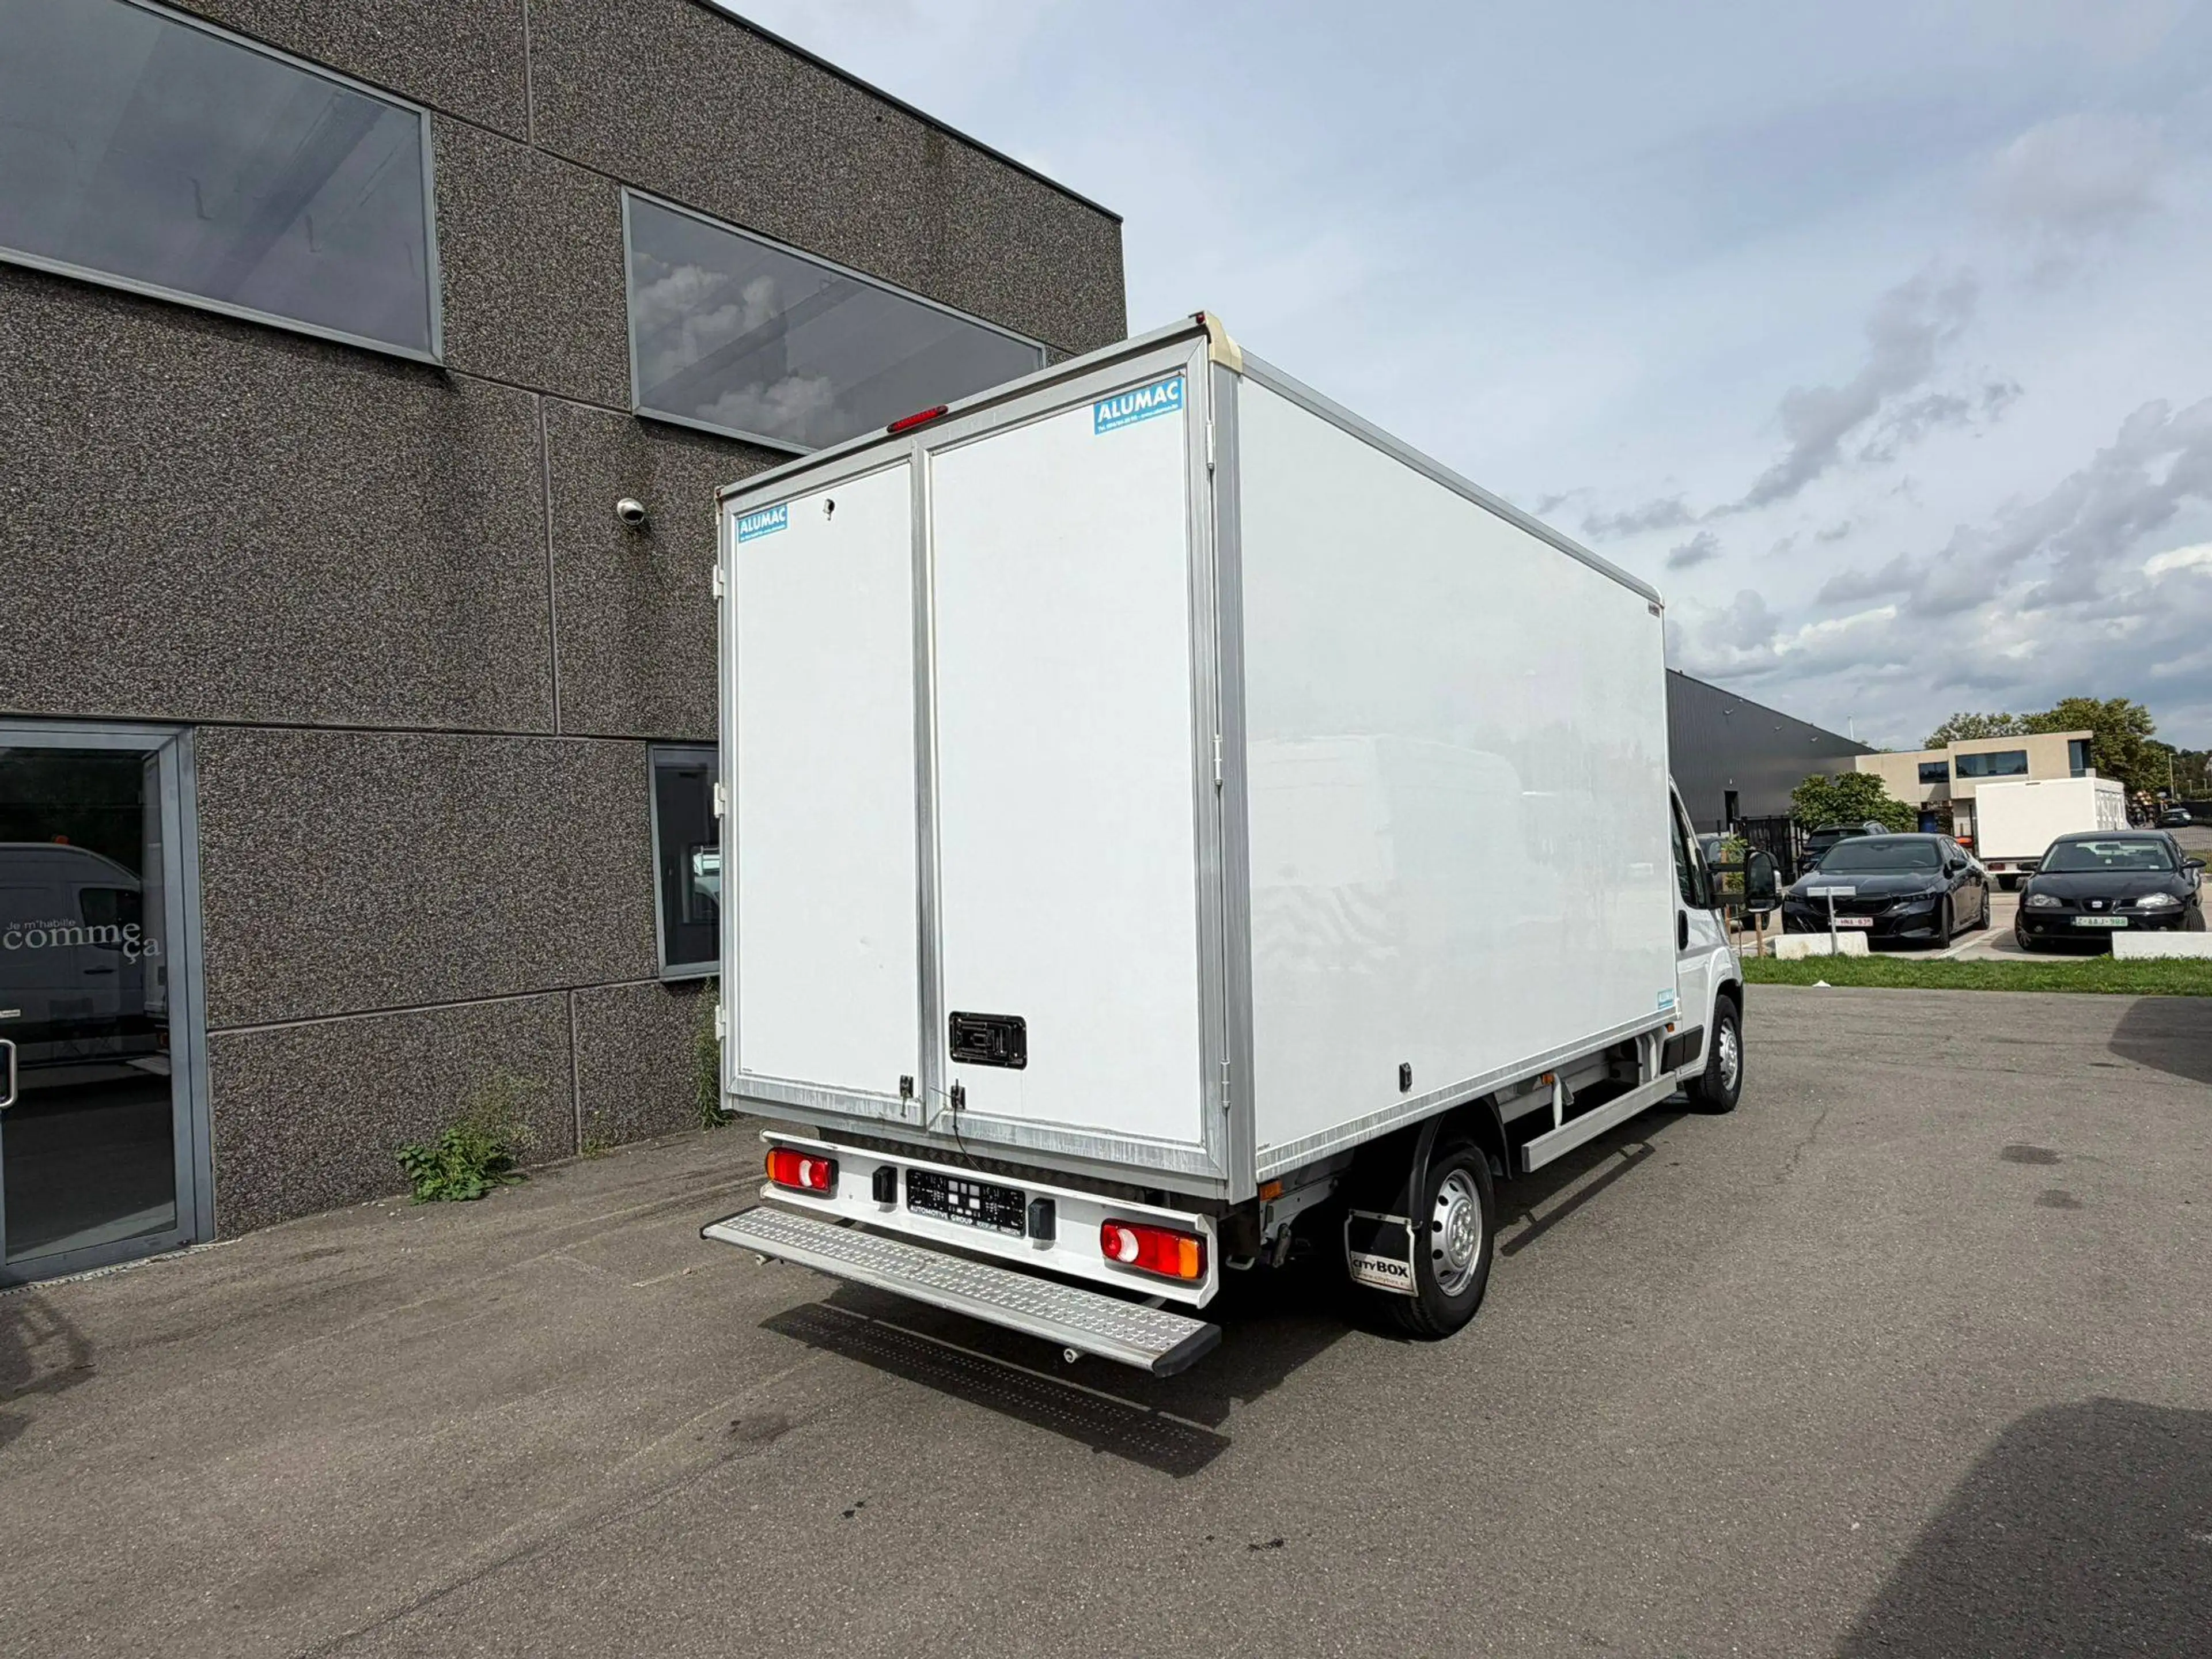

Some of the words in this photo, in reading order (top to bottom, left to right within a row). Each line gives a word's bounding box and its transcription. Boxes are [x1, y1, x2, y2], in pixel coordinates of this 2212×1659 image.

[1097, 381, 1179, 423] ALUMAC
[740, 507, 786, 534] ALUMAC
[3, 923, 141, 950] comme
[122, 937, 162, 965] ça
[910, 1205, 949, 1220] AUTOMOTIVE
[950, 1214, 974, 1225] GROUP
